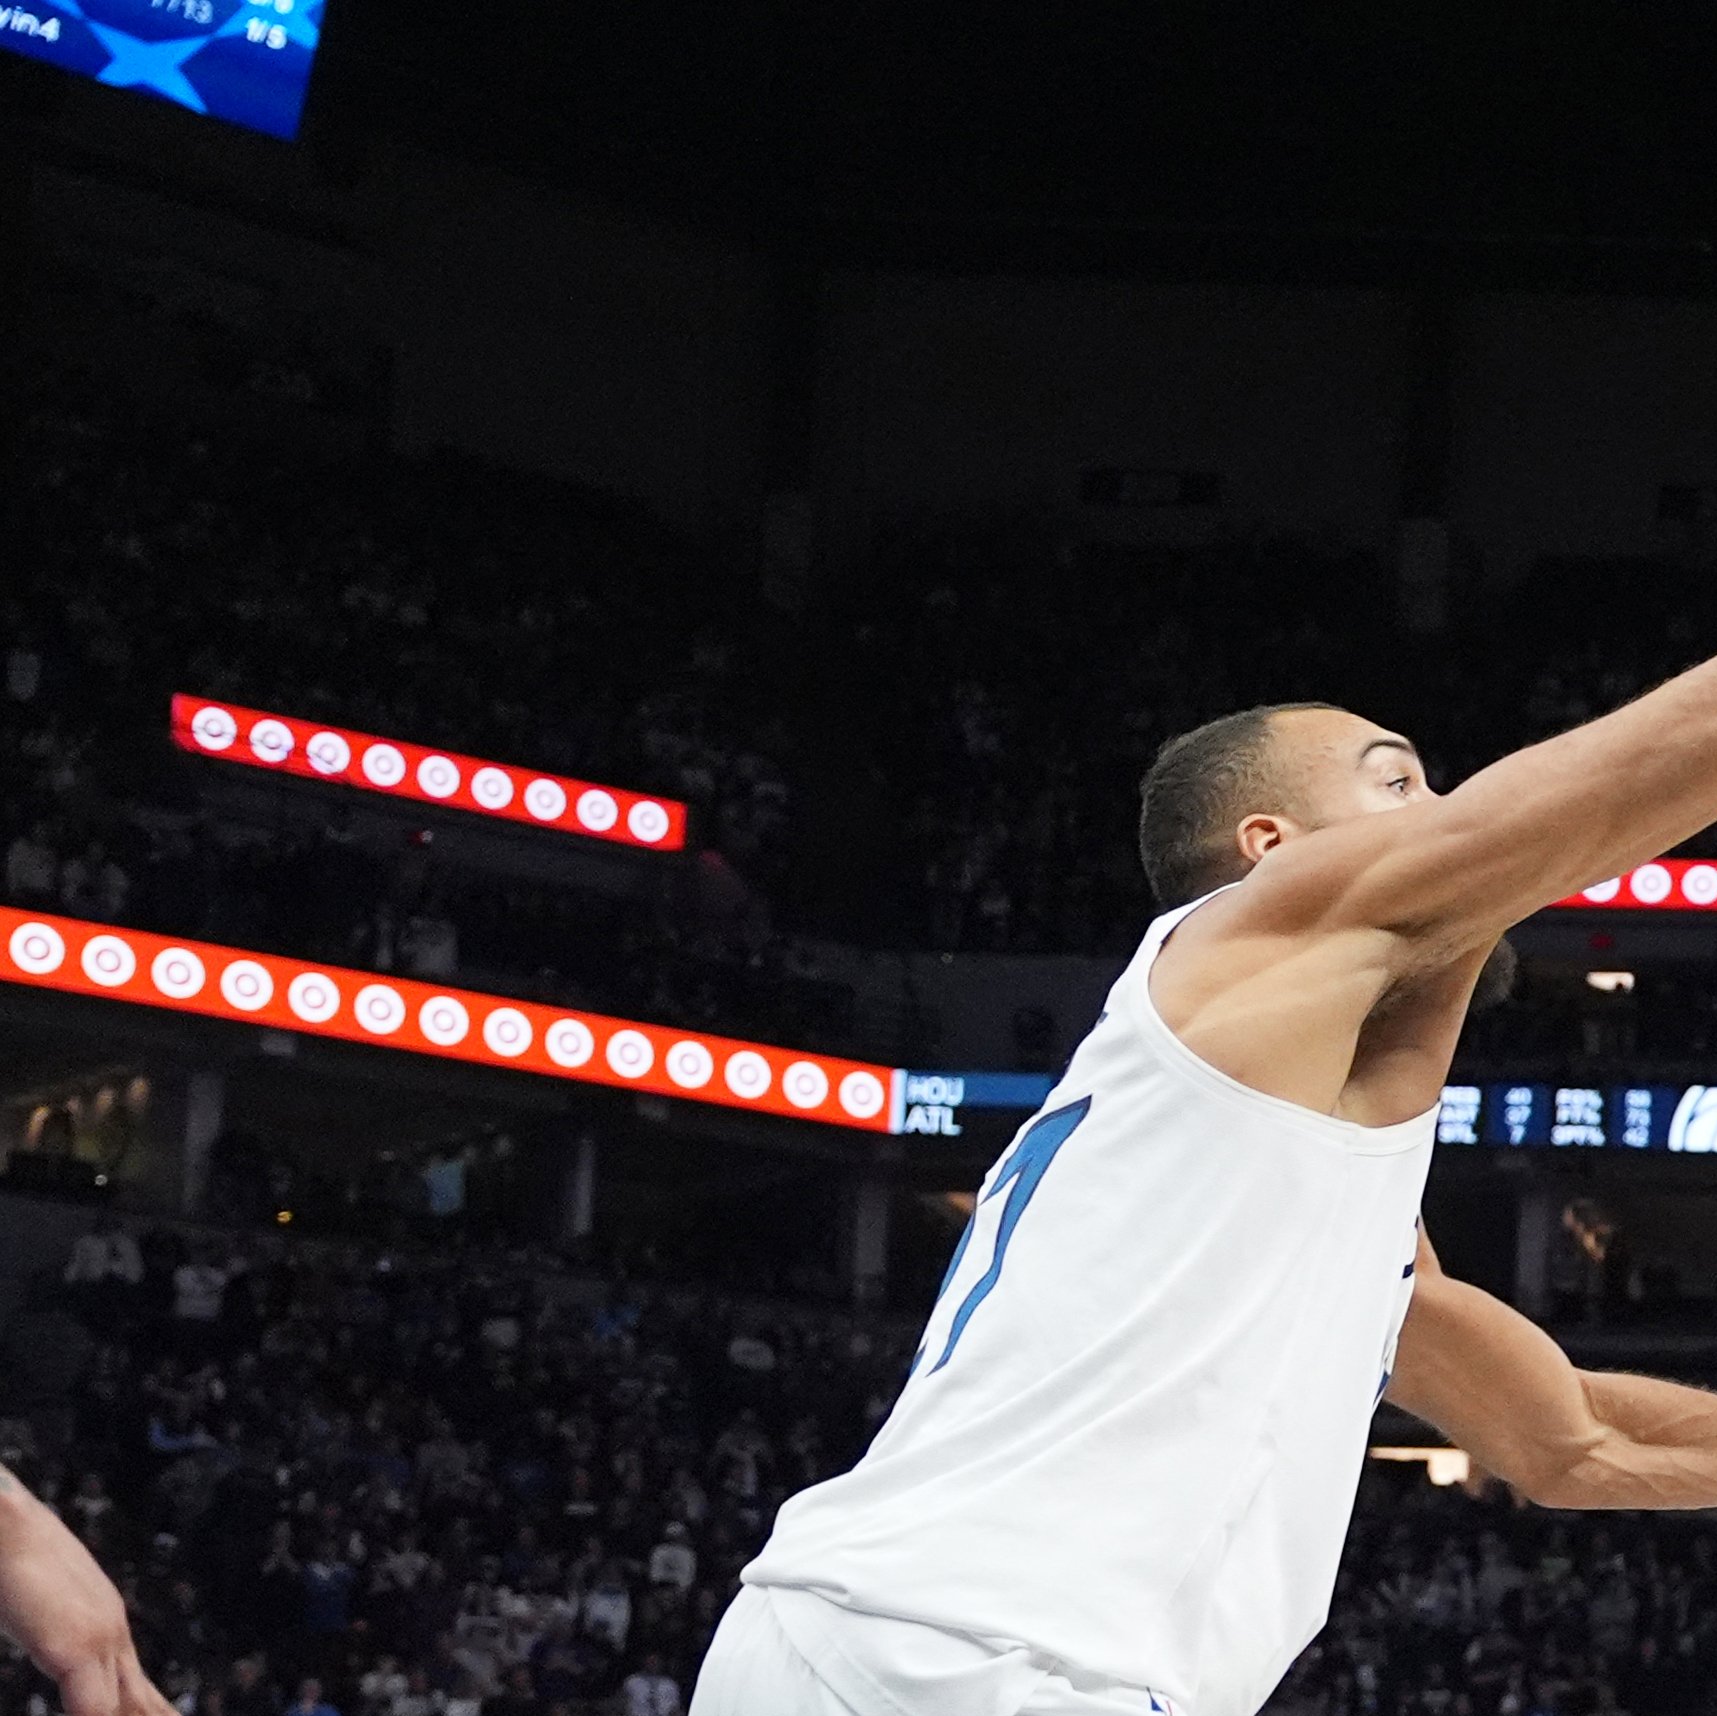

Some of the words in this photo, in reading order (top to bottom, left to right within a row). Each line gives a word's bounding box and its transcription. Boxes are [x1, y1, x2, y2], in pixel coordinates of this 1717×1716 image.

[907, 1075, 964, 1106] HOU
[904, 1104, 963, 1136] ATL
[909, 1093, 1093, 1378] 7
